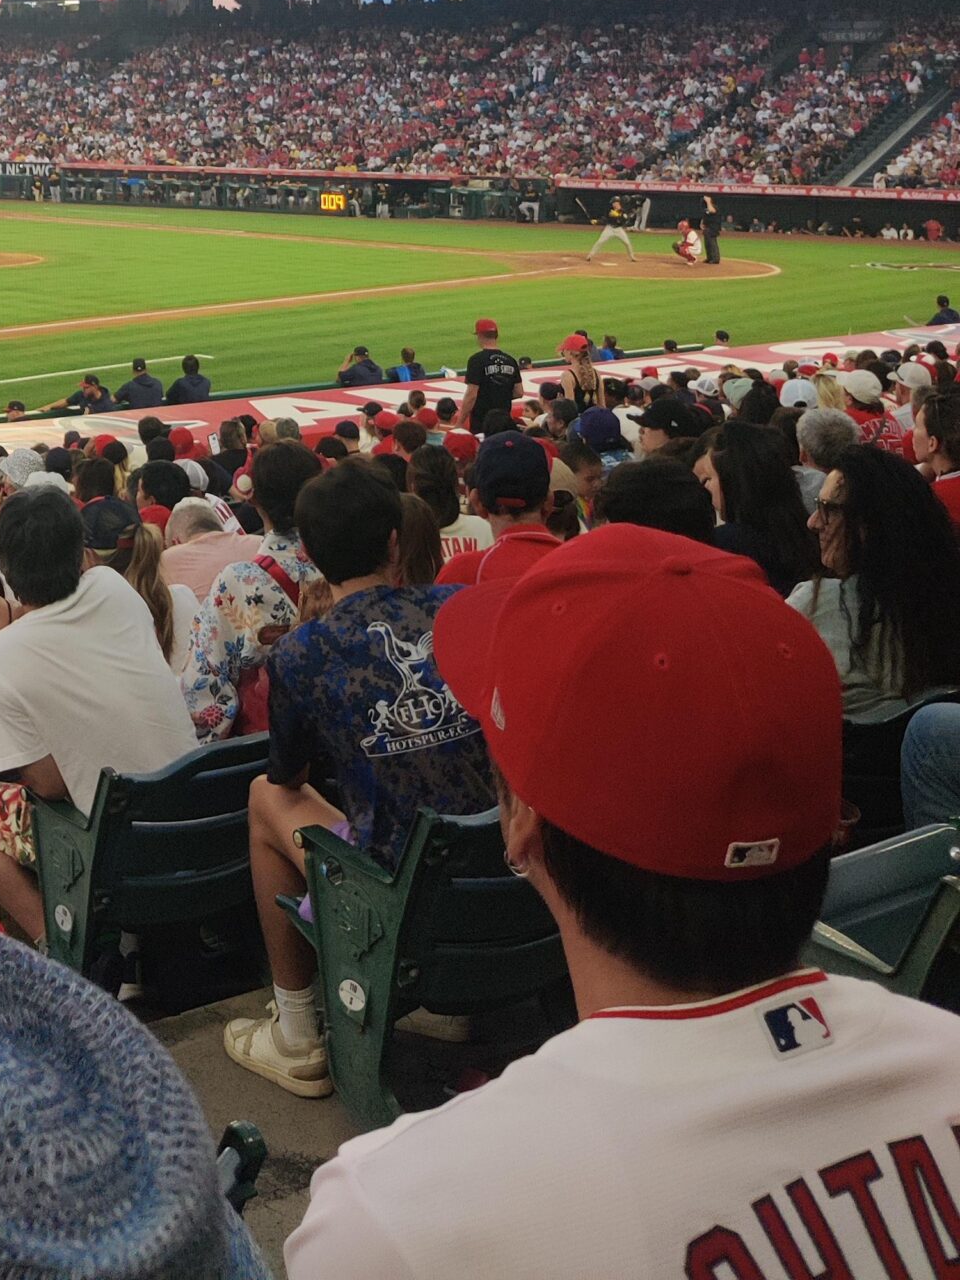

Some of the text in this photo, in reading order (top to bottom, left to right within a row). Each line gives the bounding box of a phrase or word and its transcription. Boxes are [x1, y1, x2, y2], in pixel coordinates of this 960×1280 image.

[321, 194, 345, 210] 009
[440, 537, 478, 558] TANI
[685, 1124, 960, 1280] HTA
